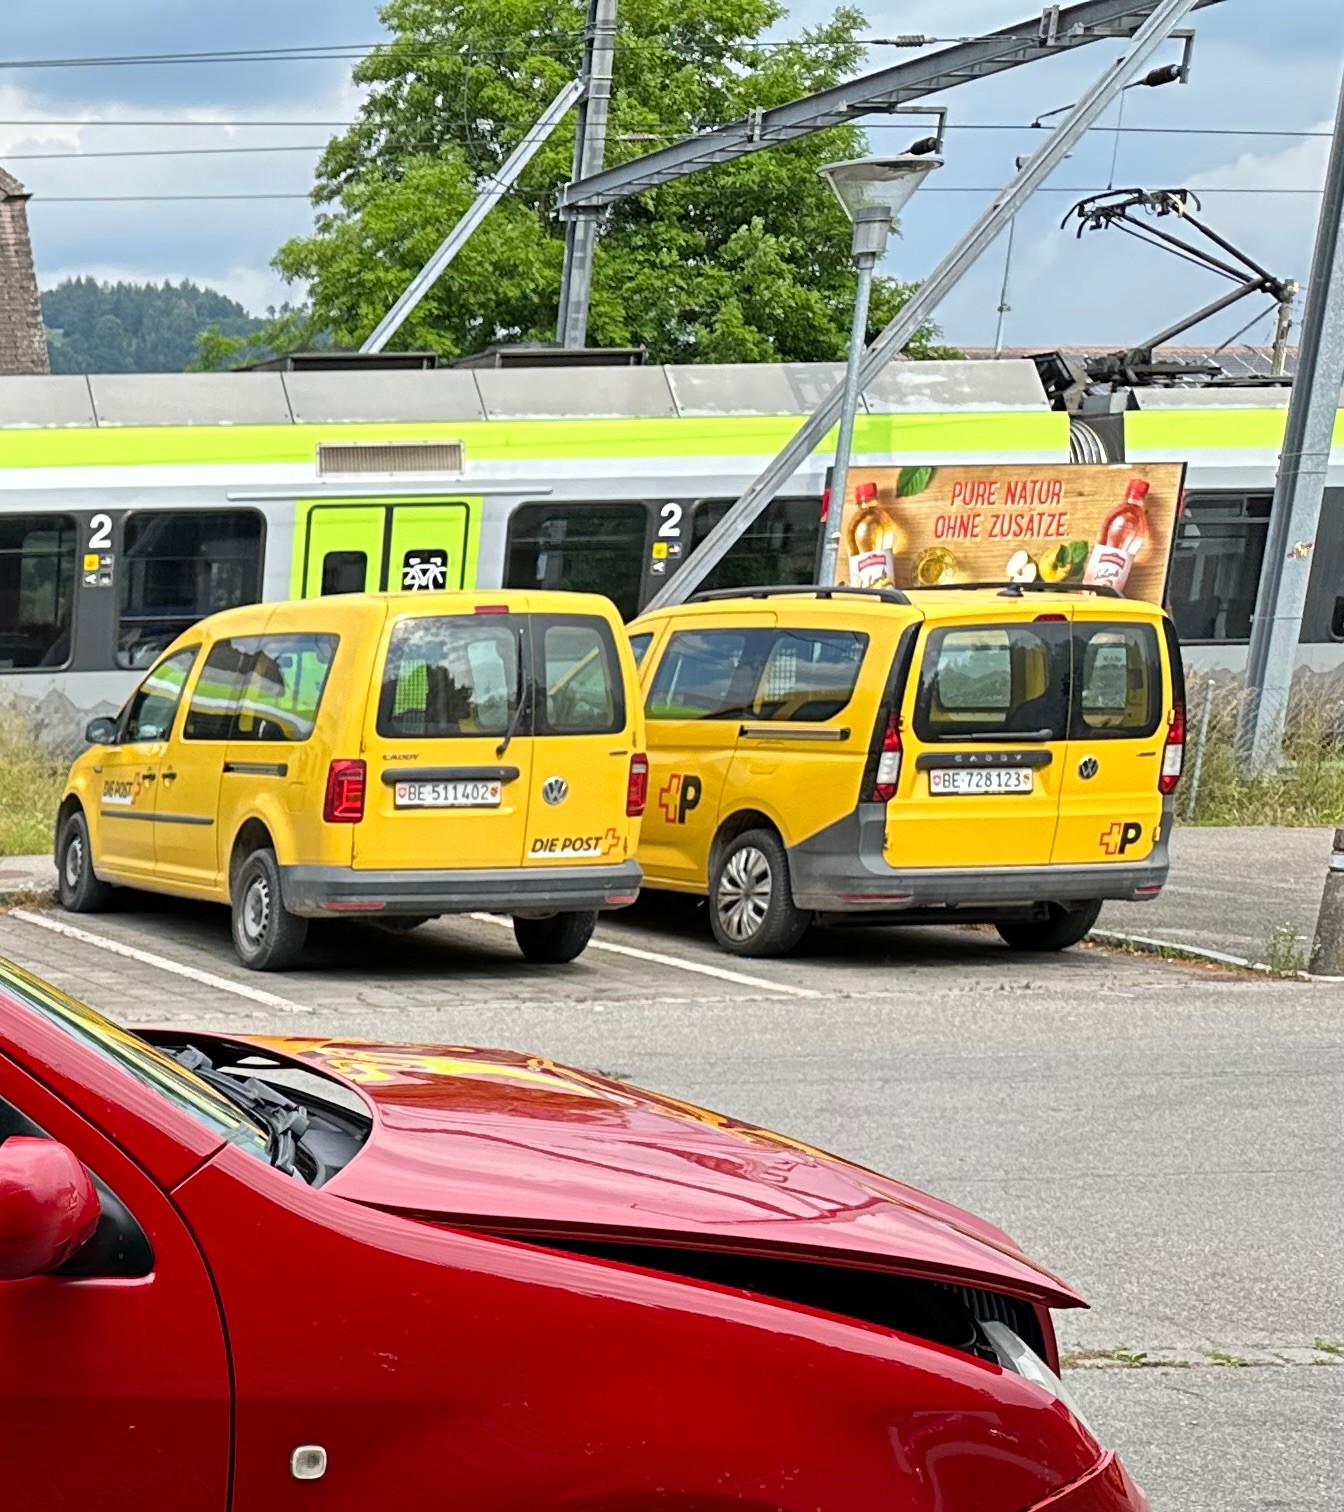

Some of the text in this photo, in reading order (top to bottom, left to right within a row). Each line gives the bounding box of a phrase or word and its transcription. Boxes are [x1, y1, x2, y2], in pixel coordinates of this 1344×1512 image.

[951, 479, 1064, 506] PURE NATUR
[88, 513, 113, 549] 2
[658, 502, 682, 537] 2
[934, 514, 981, 538] OHNE
[531, 836, 603, 853] DIE POST
